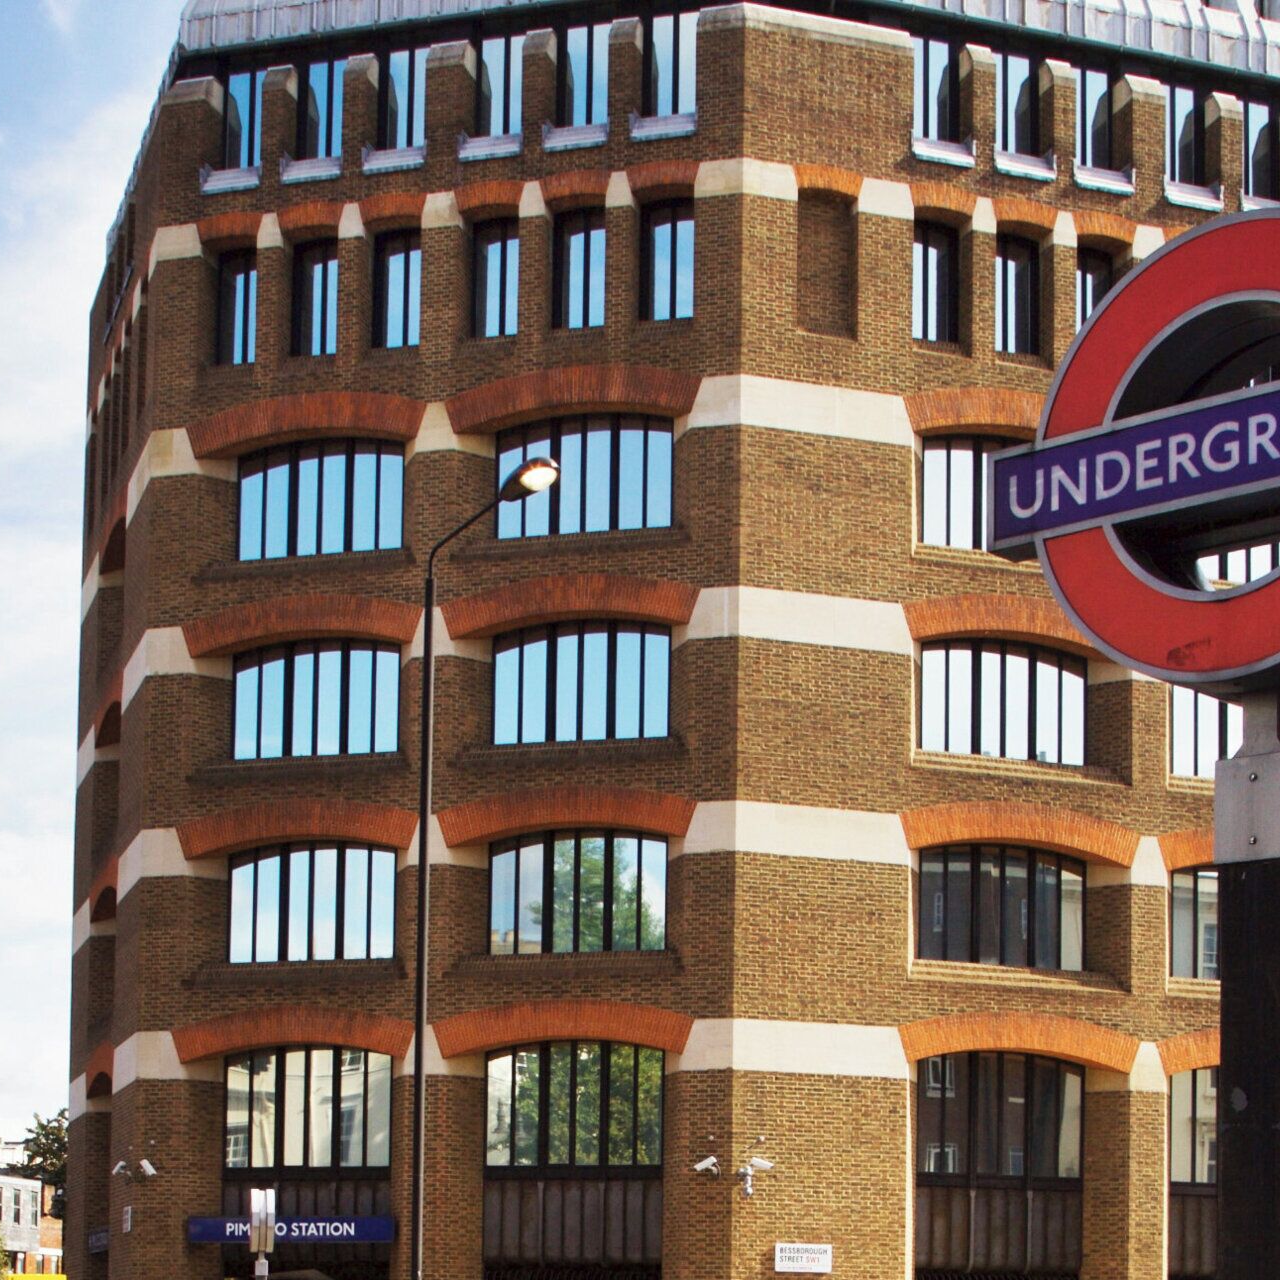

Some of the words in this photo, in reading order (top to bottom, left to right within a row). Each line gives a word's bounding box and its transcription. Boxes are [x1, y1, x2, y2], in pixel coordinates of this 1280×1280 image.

[226, 1222, 287, 1237] PIMO
[291, 1222, 355, 1237] STATION
[779, 1246, 828, 1256] BESSBOROUGH
[779, 1255, 803, 1263] STREET
